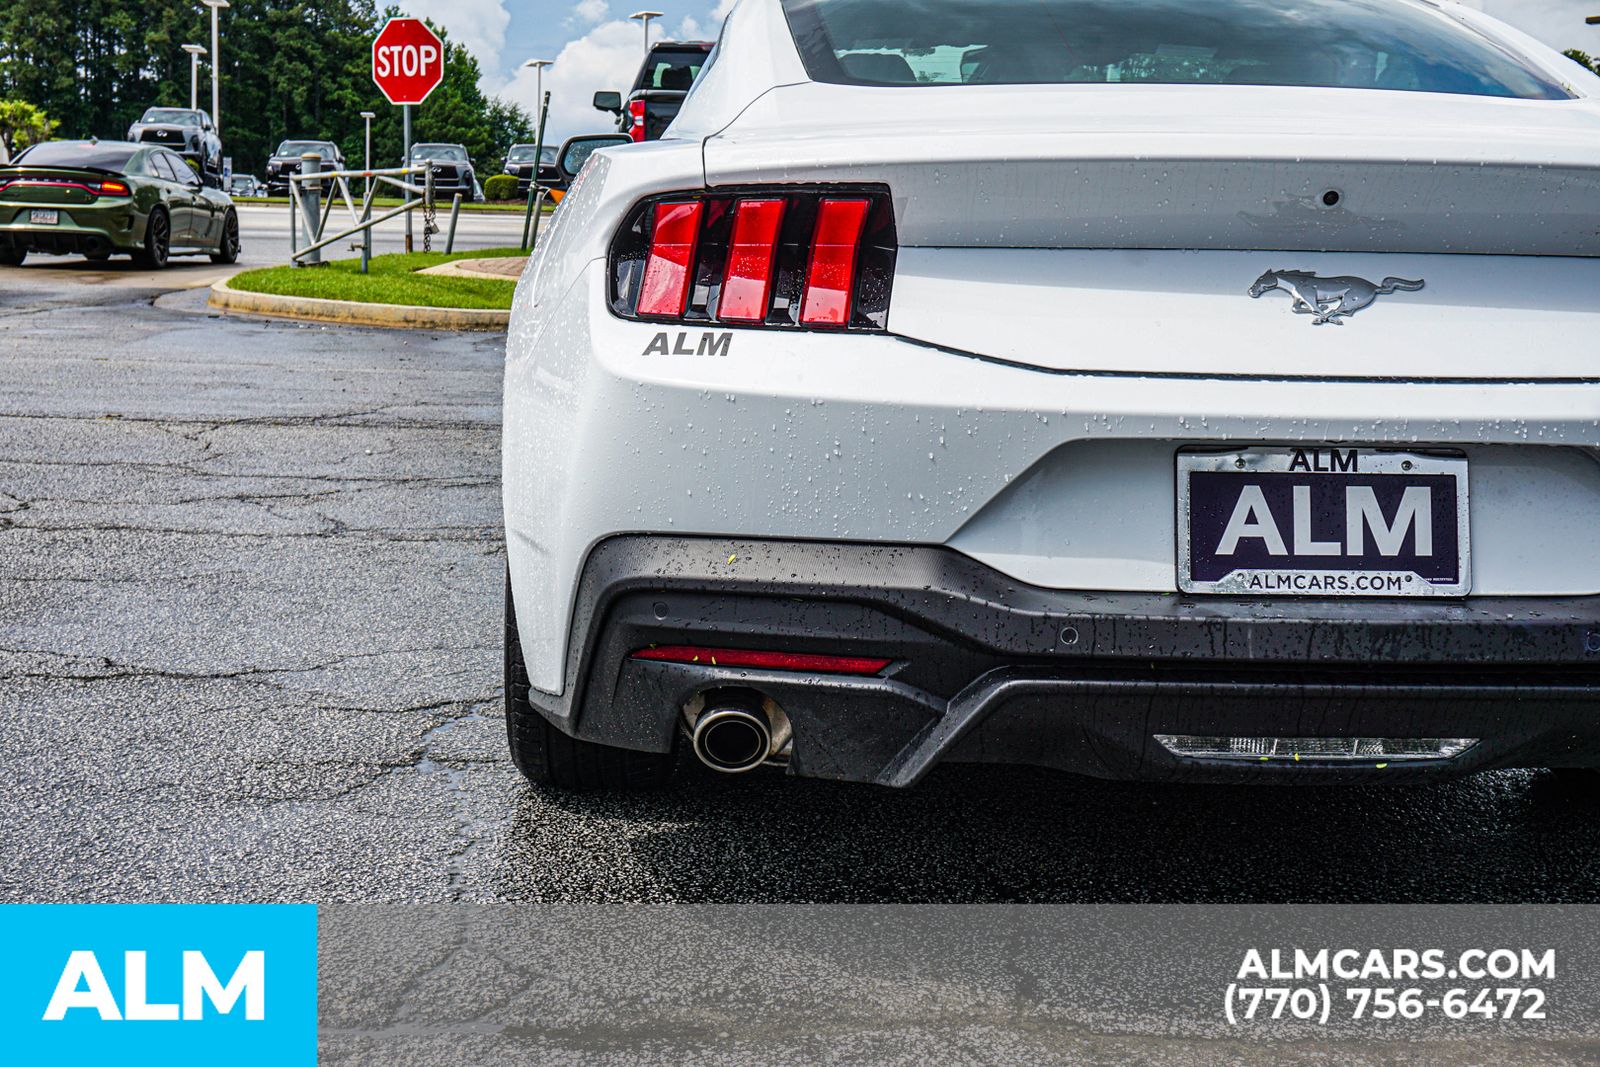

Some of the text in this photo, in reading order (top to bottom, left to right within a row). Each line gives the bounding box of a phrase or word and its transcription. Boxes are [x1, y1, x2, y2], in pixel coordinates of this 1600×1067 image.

[377, 44, 437, 78] STOP
[642, 332, 733, 356] ALM
[1289, 448, 1358, 472] ALM
[1215, 485, 1433, 556] ALM
[1249, 574, 1402, 591] ALMCARS.COM
